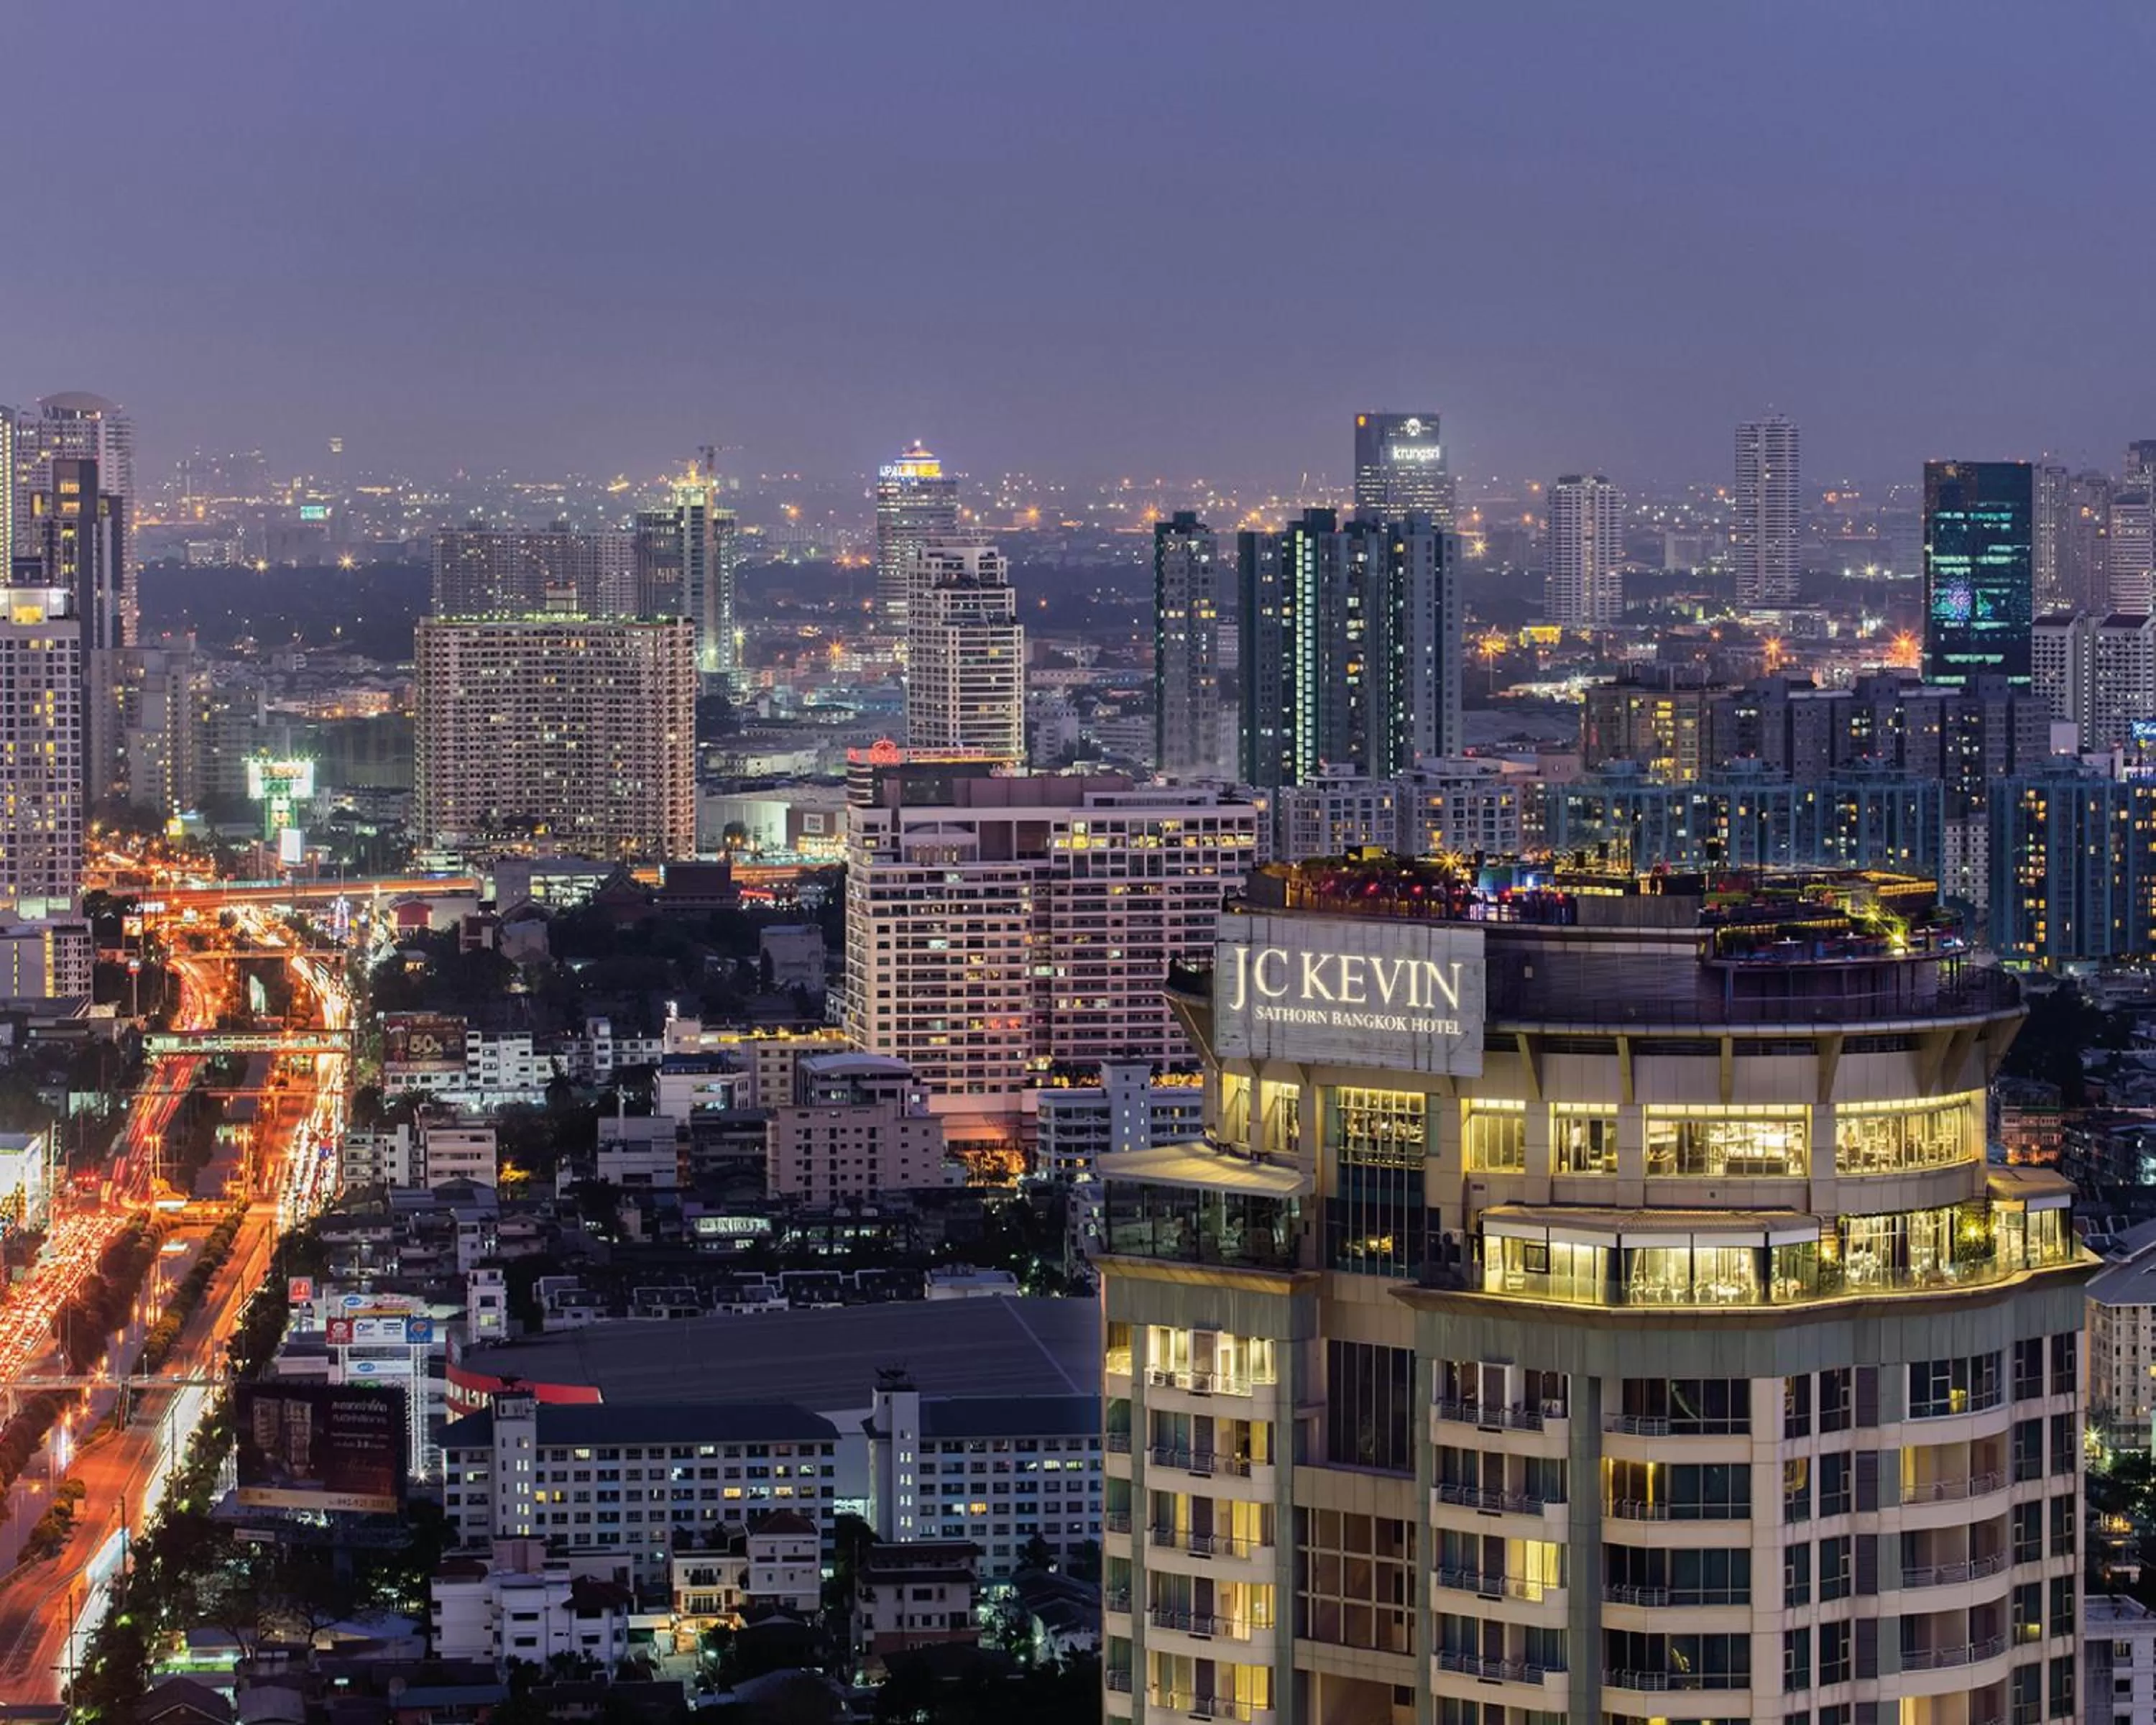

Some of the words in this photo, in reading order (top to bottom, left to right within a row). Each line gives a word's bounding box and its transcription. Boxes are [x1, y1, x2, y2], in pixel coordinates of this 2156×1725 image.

[1393, 445, 1440, 462] krungsri
[1229, 947, 1289, 1011] JC
[1299, 951, 1463, 1010] KEVIN
[1256, 1005, 1328, 1025] SATHORN
[1332, 1011, 1408, 1031] BANGKOK
[1410, 1017, 1462, 1036] HOTEL
